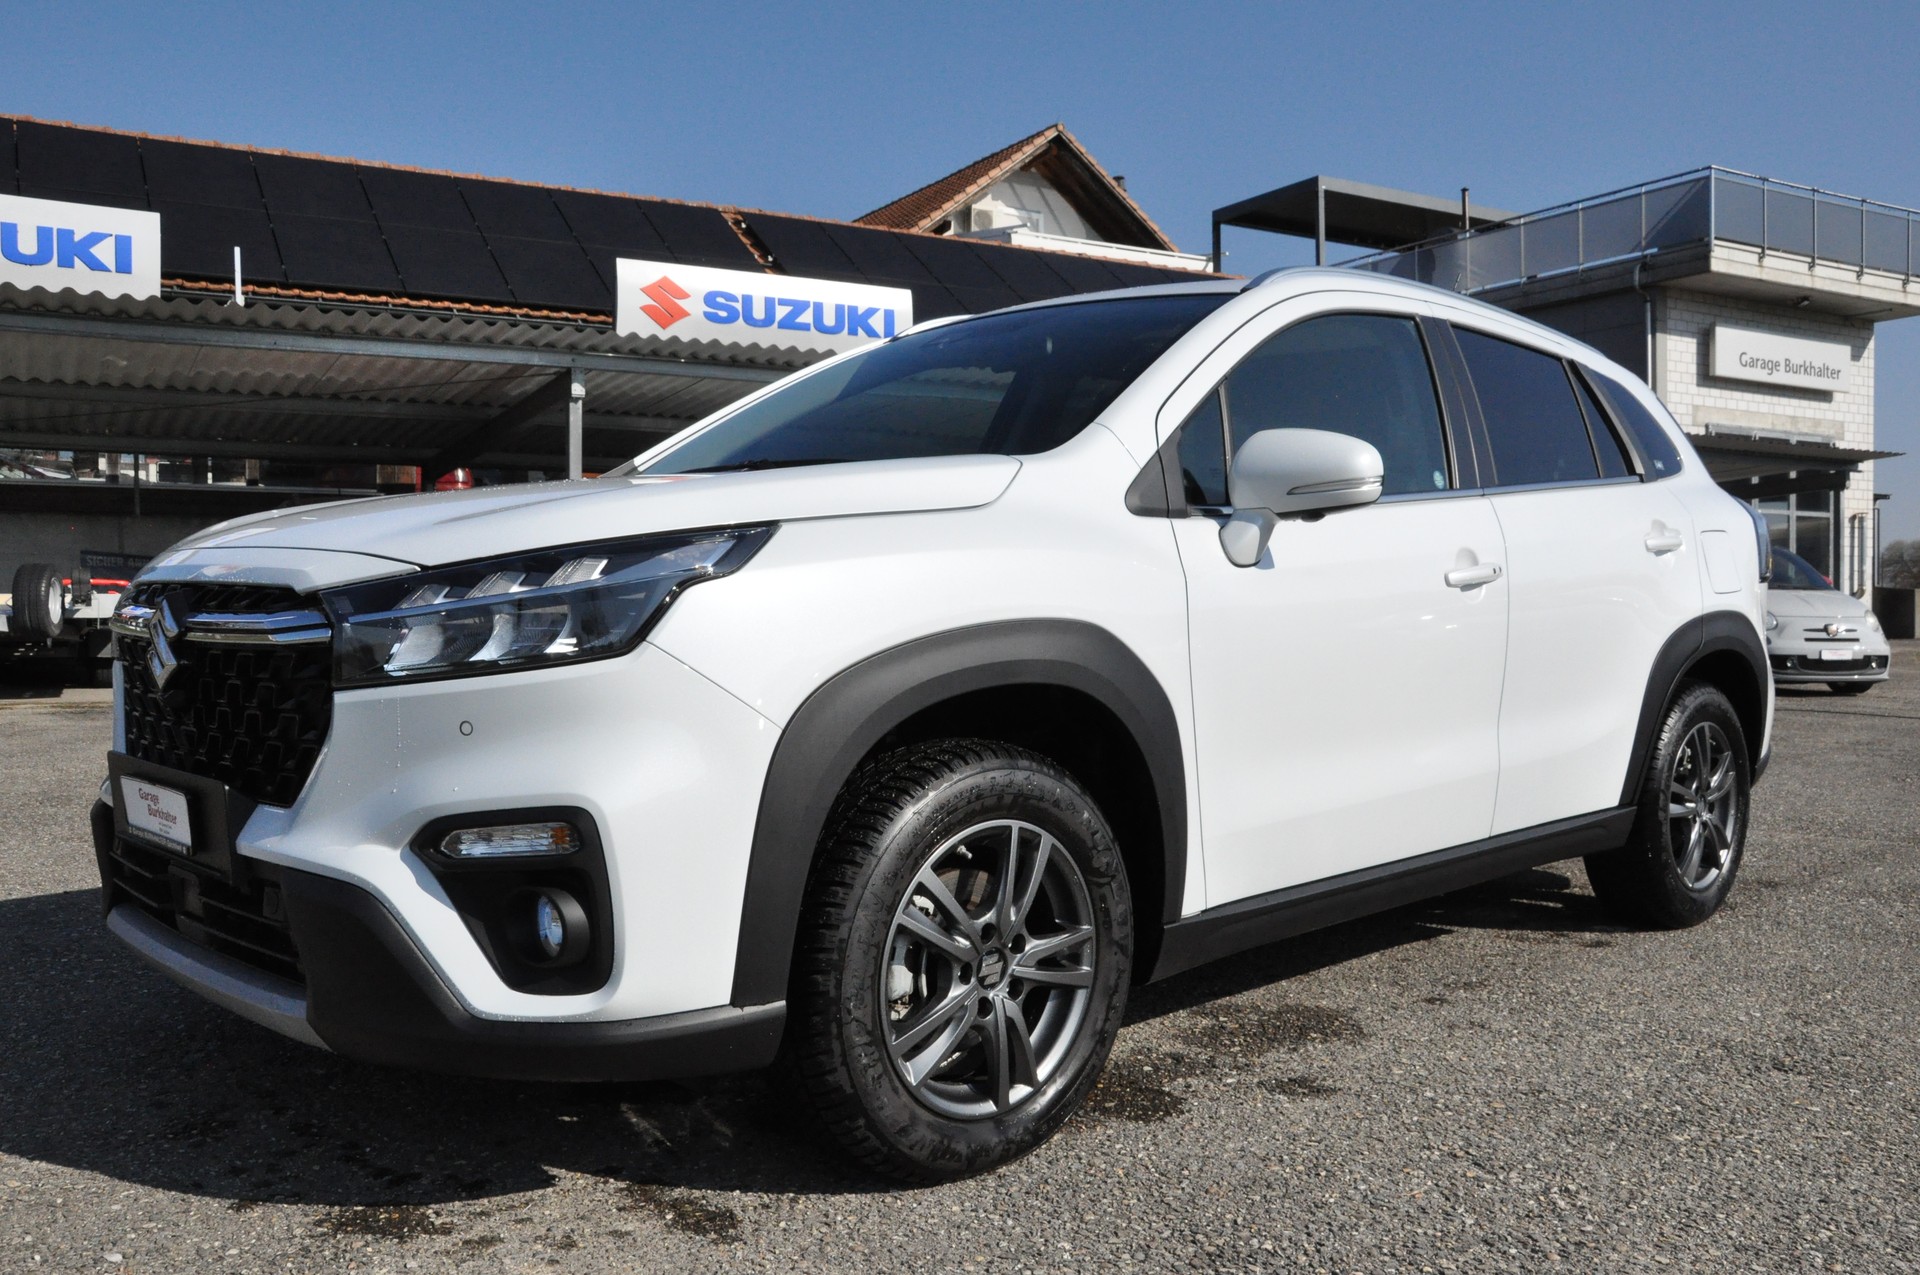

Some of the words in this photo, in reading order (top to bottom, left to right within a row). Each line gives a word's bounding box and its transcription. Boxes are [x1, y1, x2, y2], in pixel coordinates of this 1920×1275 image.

[703, 290, 895, 339] SUZUKI
[1739, 351, 1781, 376] Garage
[1784, 358, 1842, 380] Burkhalter
[138, 787, 160, 806] Garage
